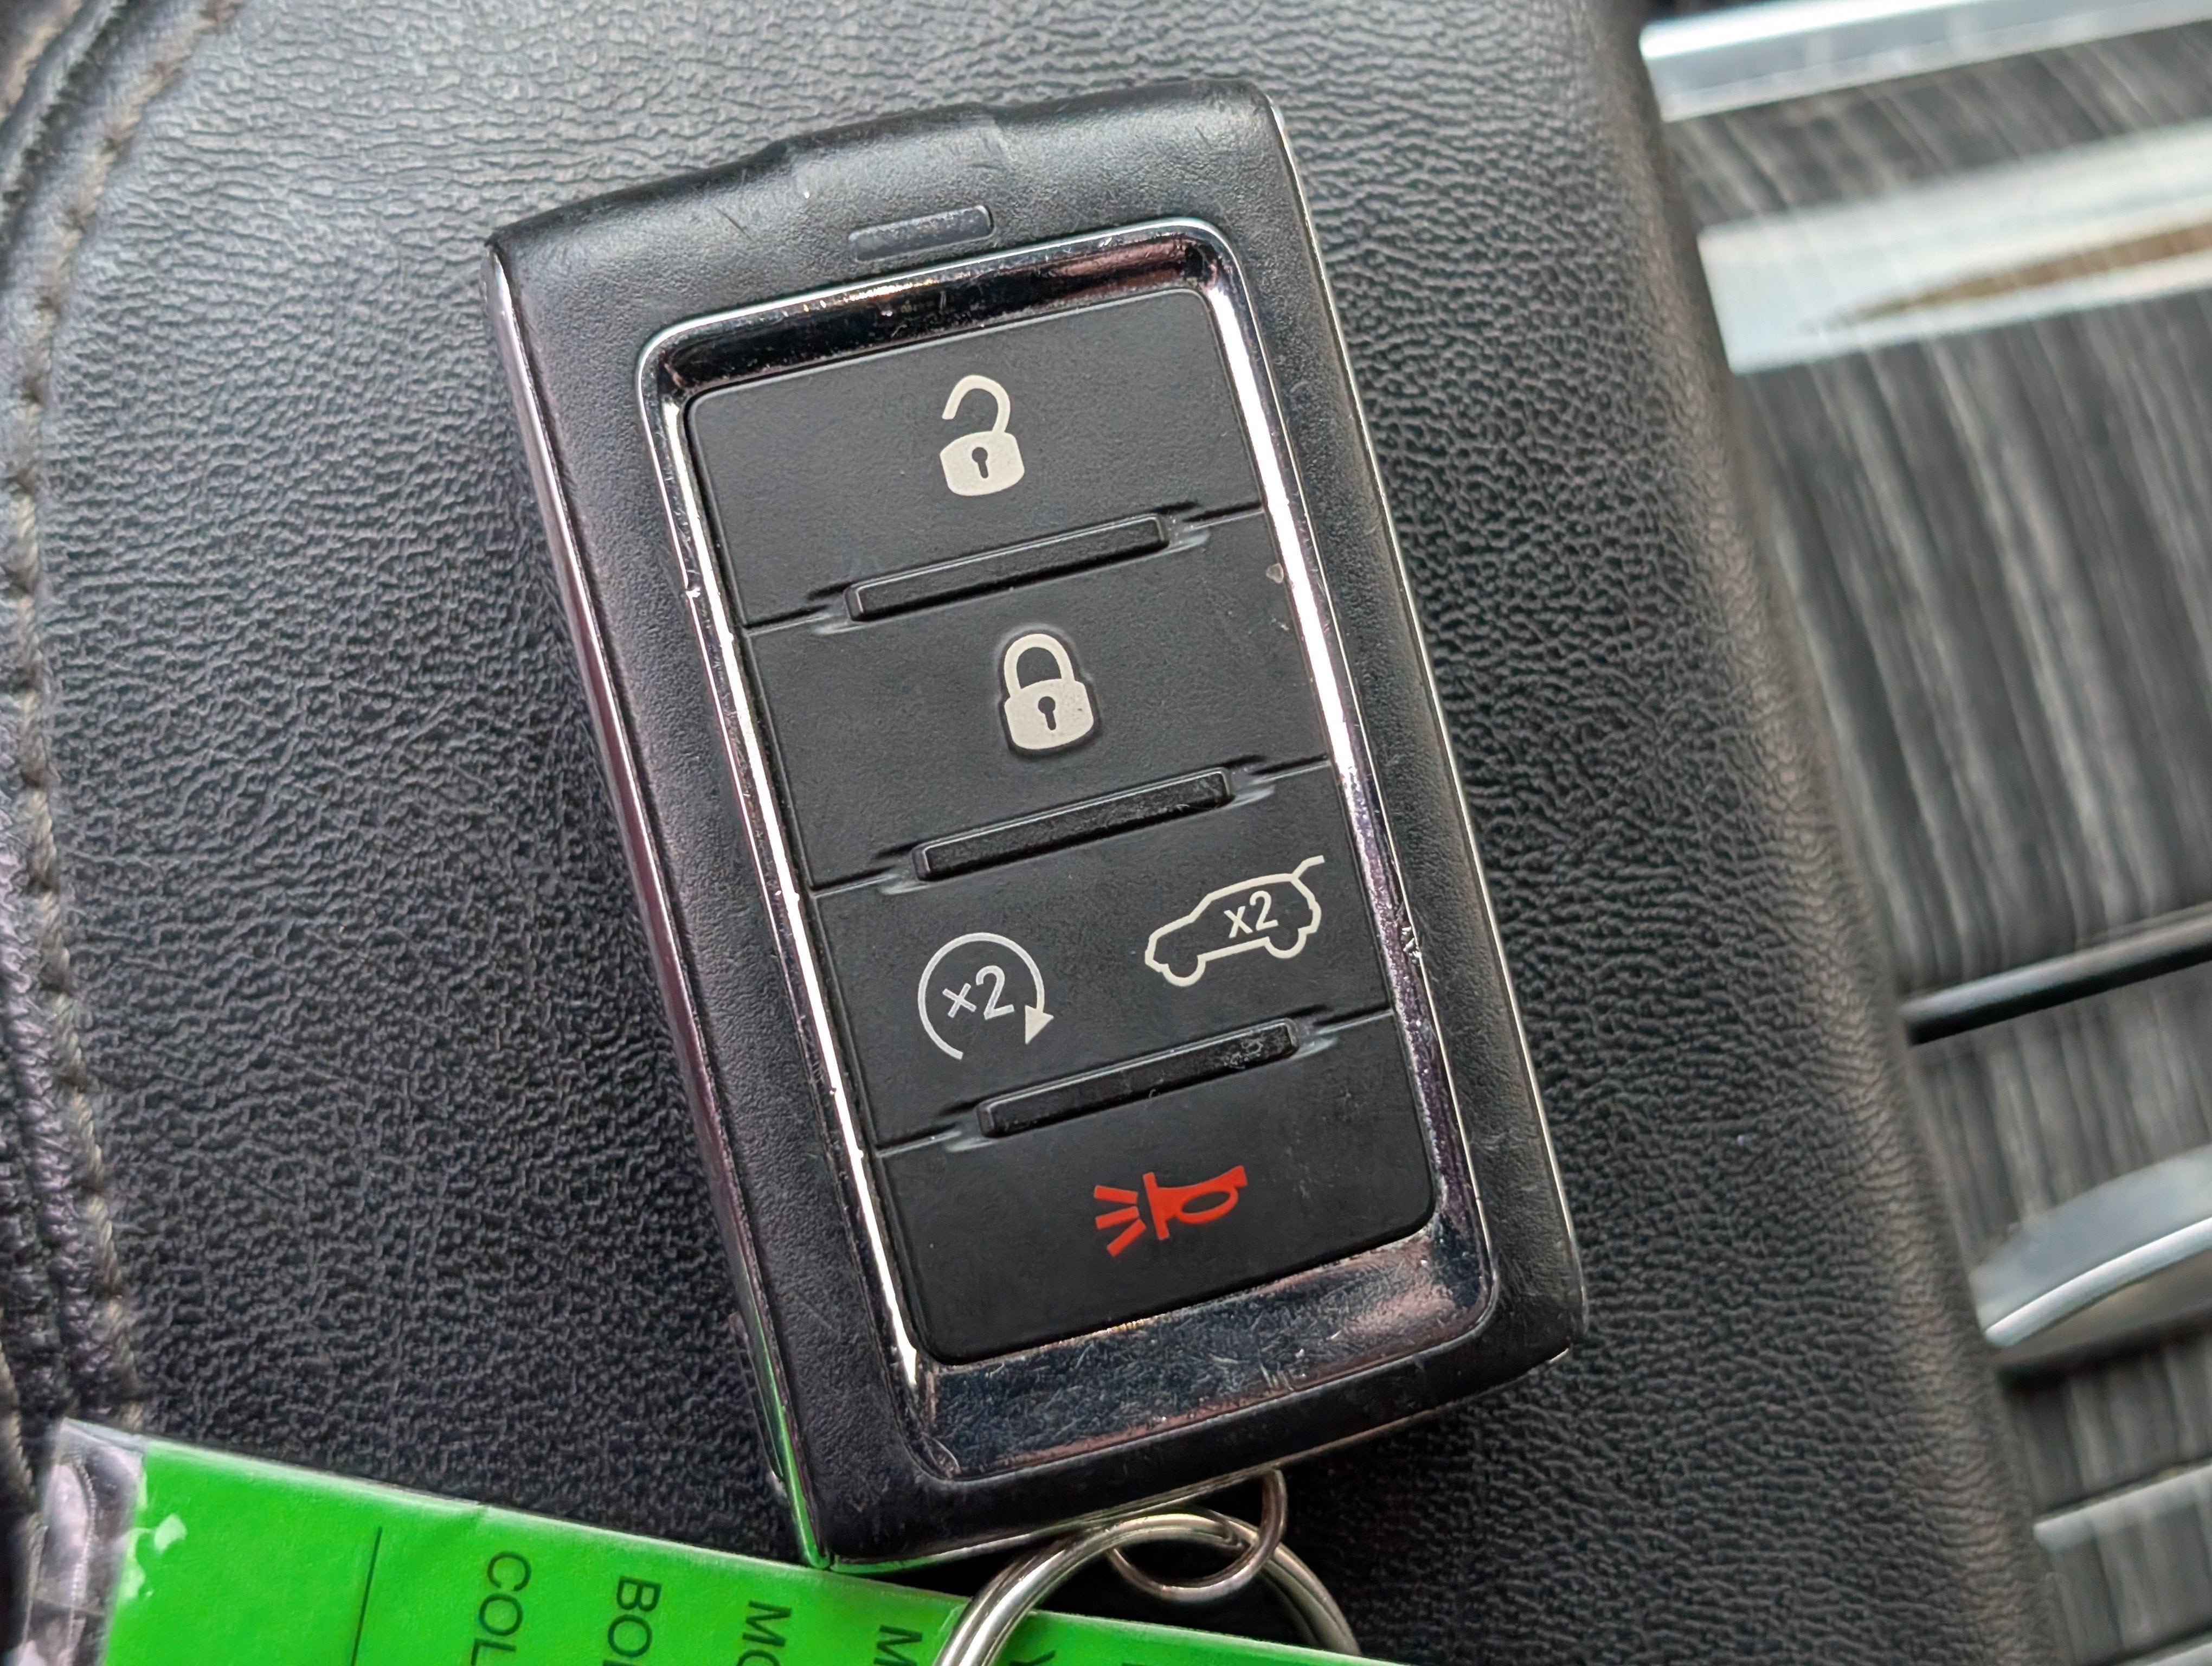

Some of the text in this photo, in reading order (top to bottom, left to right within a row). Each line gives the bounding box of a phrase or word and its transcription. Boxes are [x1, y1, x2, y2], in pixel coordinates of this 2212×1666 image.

[1224, 890, 1278, 938] x2
[942, 965, 1014, 1021] x2
[603, 1575, 662, 1666] BO
